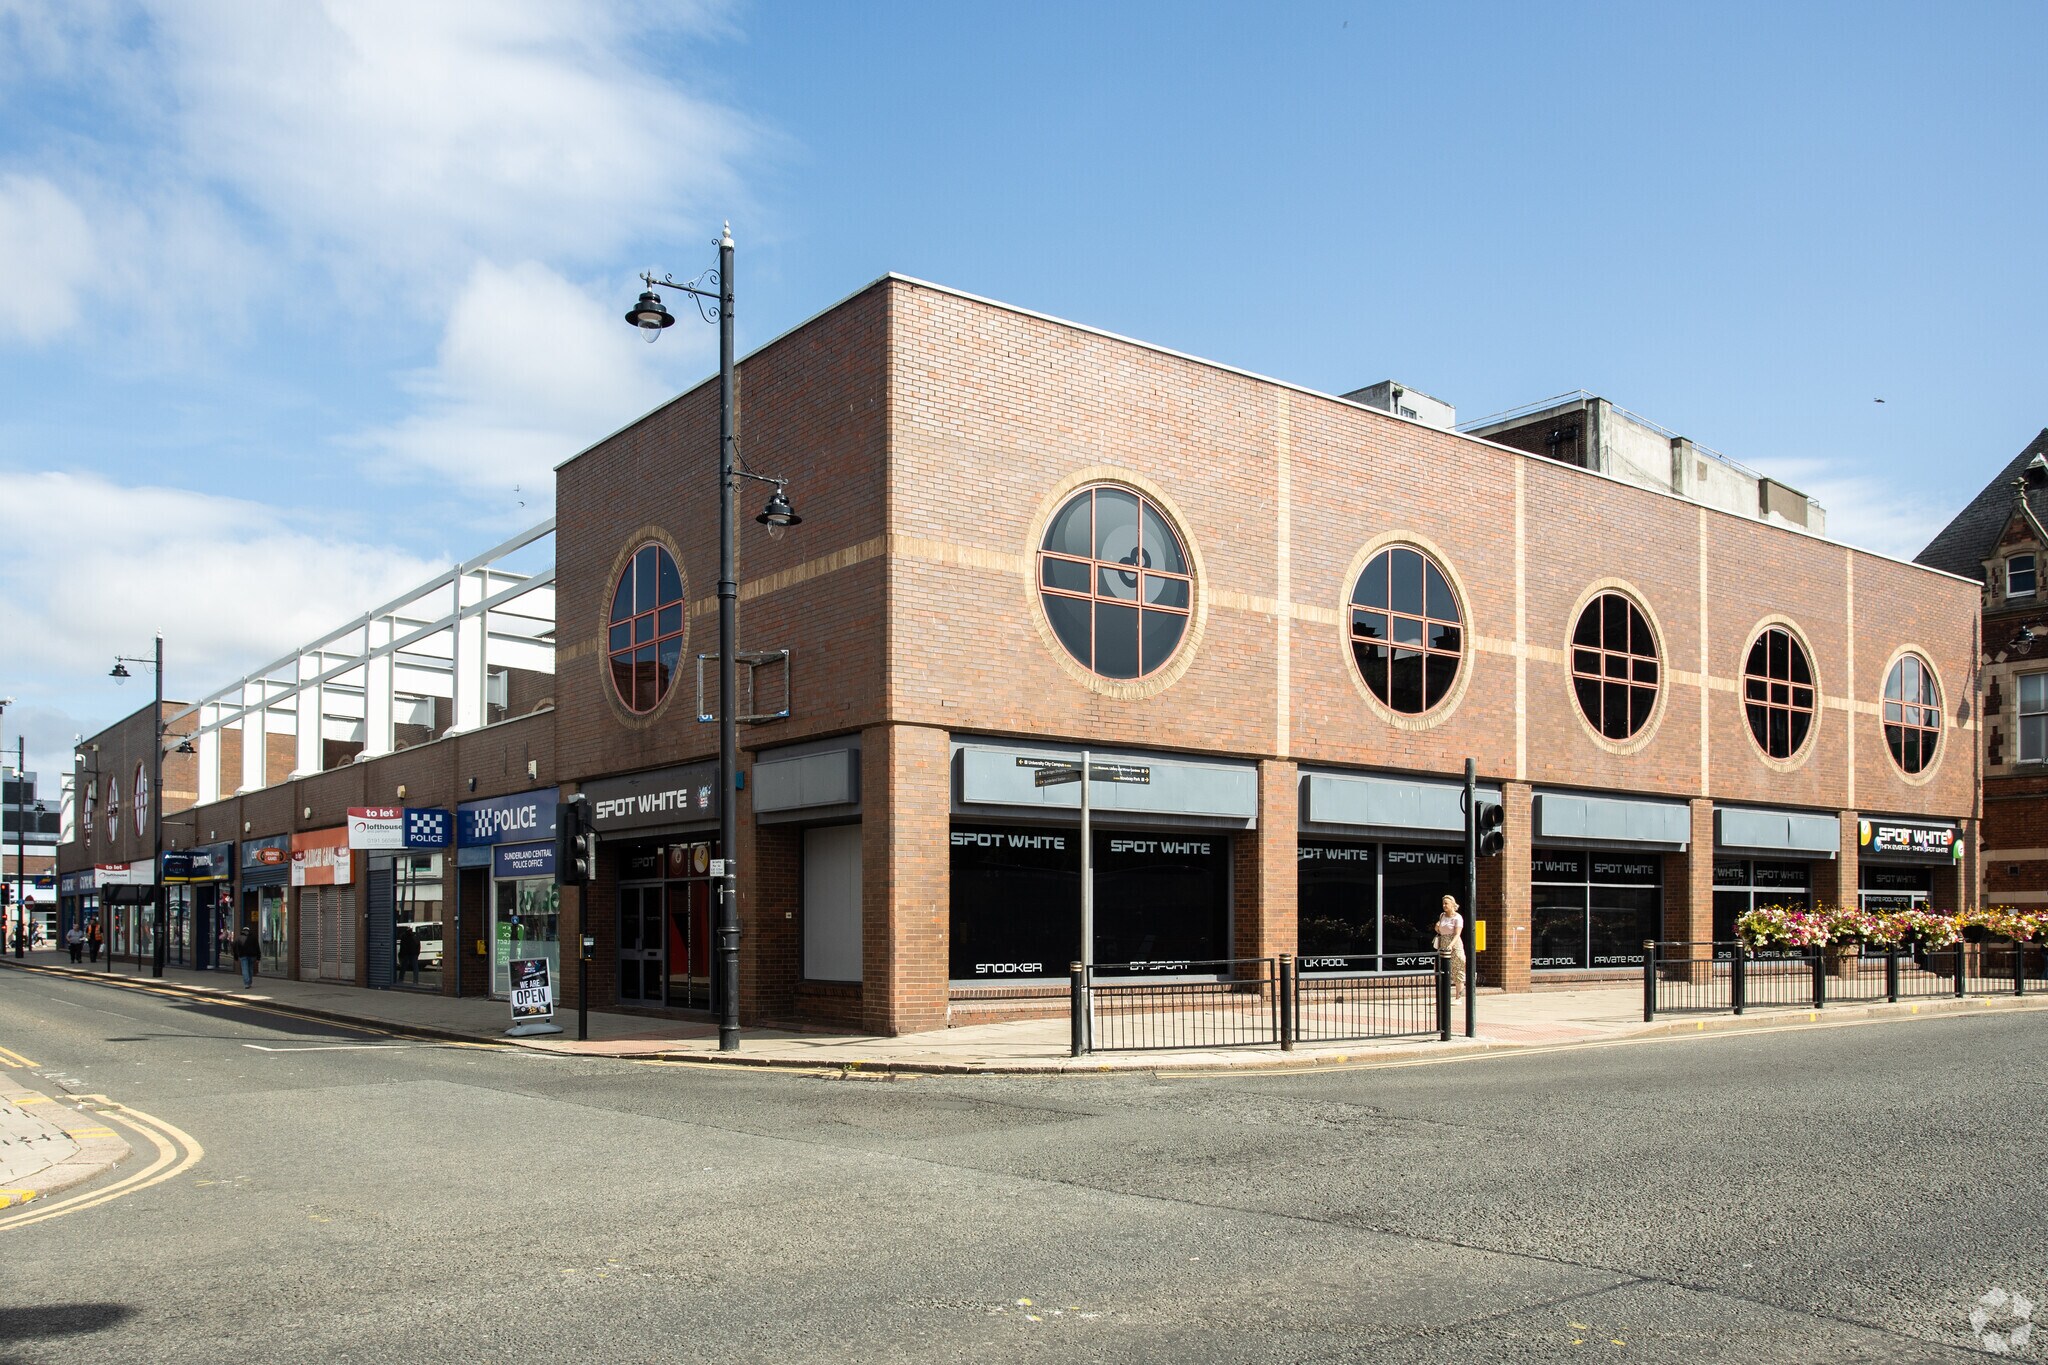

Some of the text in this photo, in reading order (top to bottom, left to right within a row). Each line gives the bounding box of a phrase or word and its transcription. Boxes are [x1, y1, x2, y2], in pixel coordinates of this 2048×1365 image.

[596, 797, 636, 819] SPOT
[638, 789, 687, 813] WHITE
[365, 808, 394, 818] to let
[494, 805, 537, 832] POLICE
[411, 835, 443, 843] POLICE
[951, 832, 1065, 850] SPOT WHITE
[1879, 827, 1949, 845] SPOT WHITE
[1111, 840, 1211, 854] SPOT WHITE
[504, 849, 553, 860] SUNDERLAND CENTRAL
[1298, 847, 1368, 861] POT WHITE
[1389, 852, 1464, 865] SPOT WHITE
[512, 859, 543, 869] POLICE OFFICE
[632, 856, 655, 868] SPOT
[1545, 861, 1578, 872] WHITE
[1594, 863, 1654, 874] SPOT WHITE
[1717, 867, 1744, 878] WHITE
[1756, 869, 1804, 880] SPOT WHITE
[1876, 874, 1917, 883] SPOT WHITE
[1304, 957, 1349, 967] UK POOL
[1396, 956, 1435, 966] SKY SPO
[1531, 957, 1577, 966] RICAN POOL
[1594, 955, 1644, 964] PRIVATE ROO
[975, 963, 1043, 974] SNOOKER
[520, 979, 541, 989] WE ARE
[516, 988, 546, 1005] OPEN
